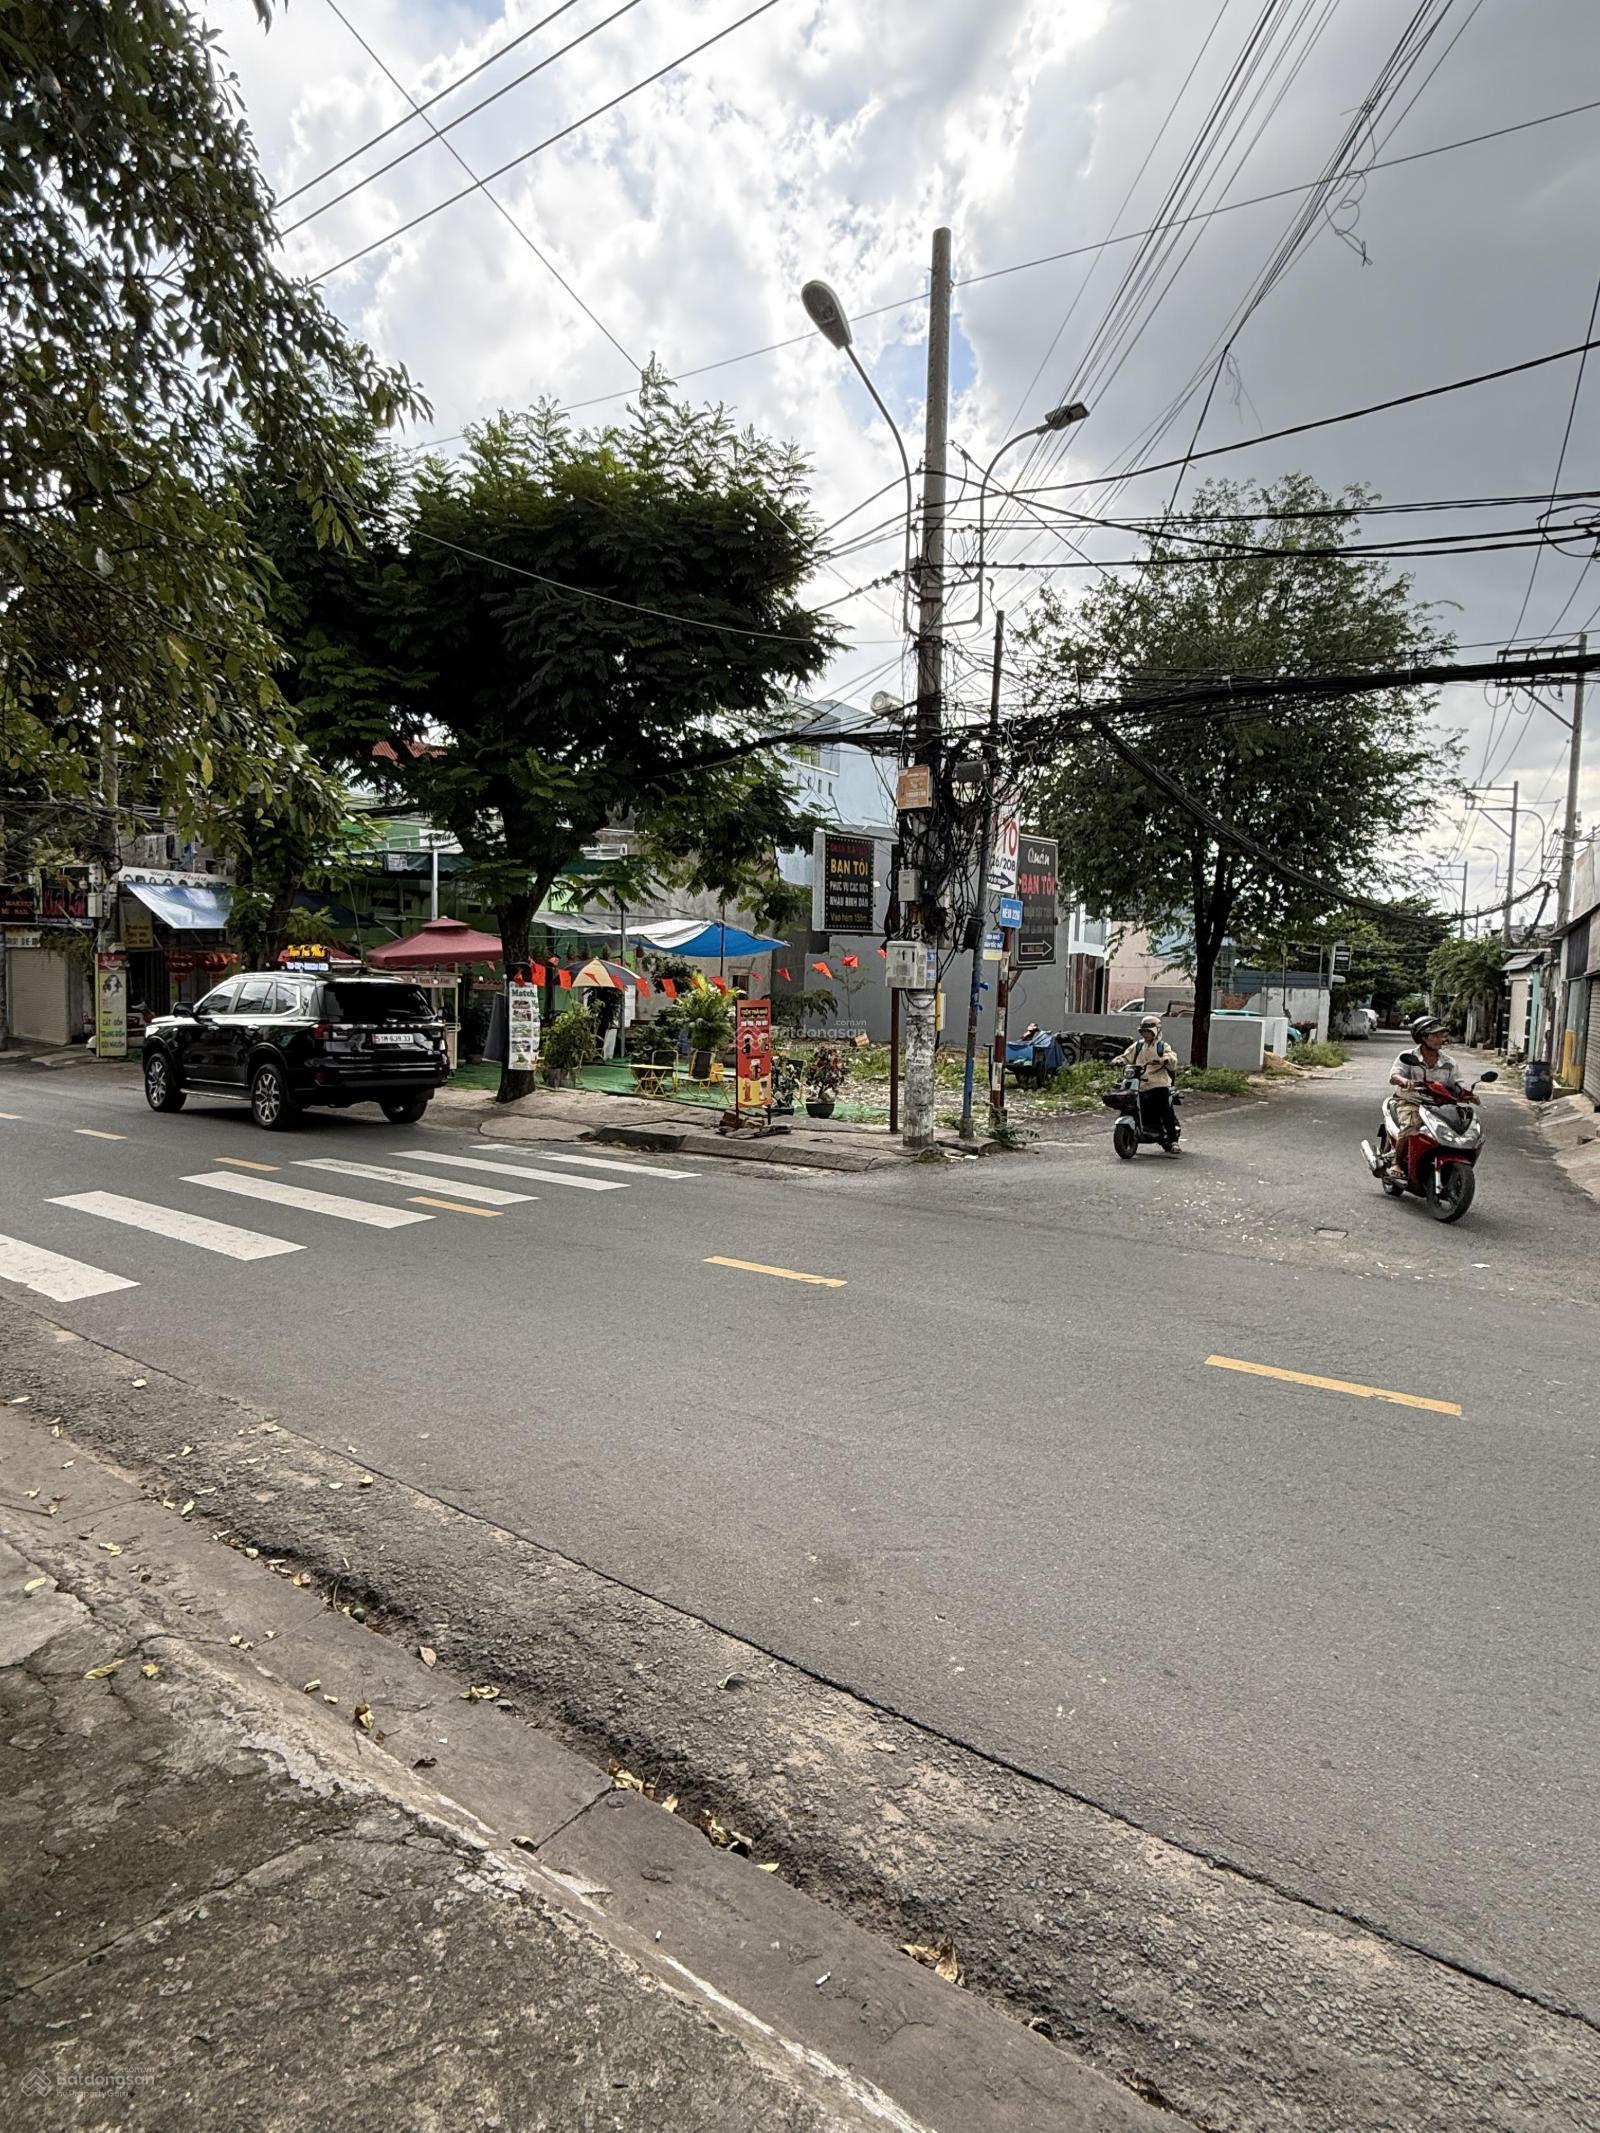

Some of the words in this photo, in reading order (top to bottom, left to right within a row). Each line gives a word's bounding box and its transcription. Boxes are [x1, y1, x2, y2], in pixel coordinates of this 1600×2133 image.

[1027, 846, 1050, 866] Quán
[830, 858, 851, 878] BẠN
[853, 858, 869, 876] TÔI
[1020, 873, 1040, 900] BẠN
[1042, 871, 1056, 896] TÔI
